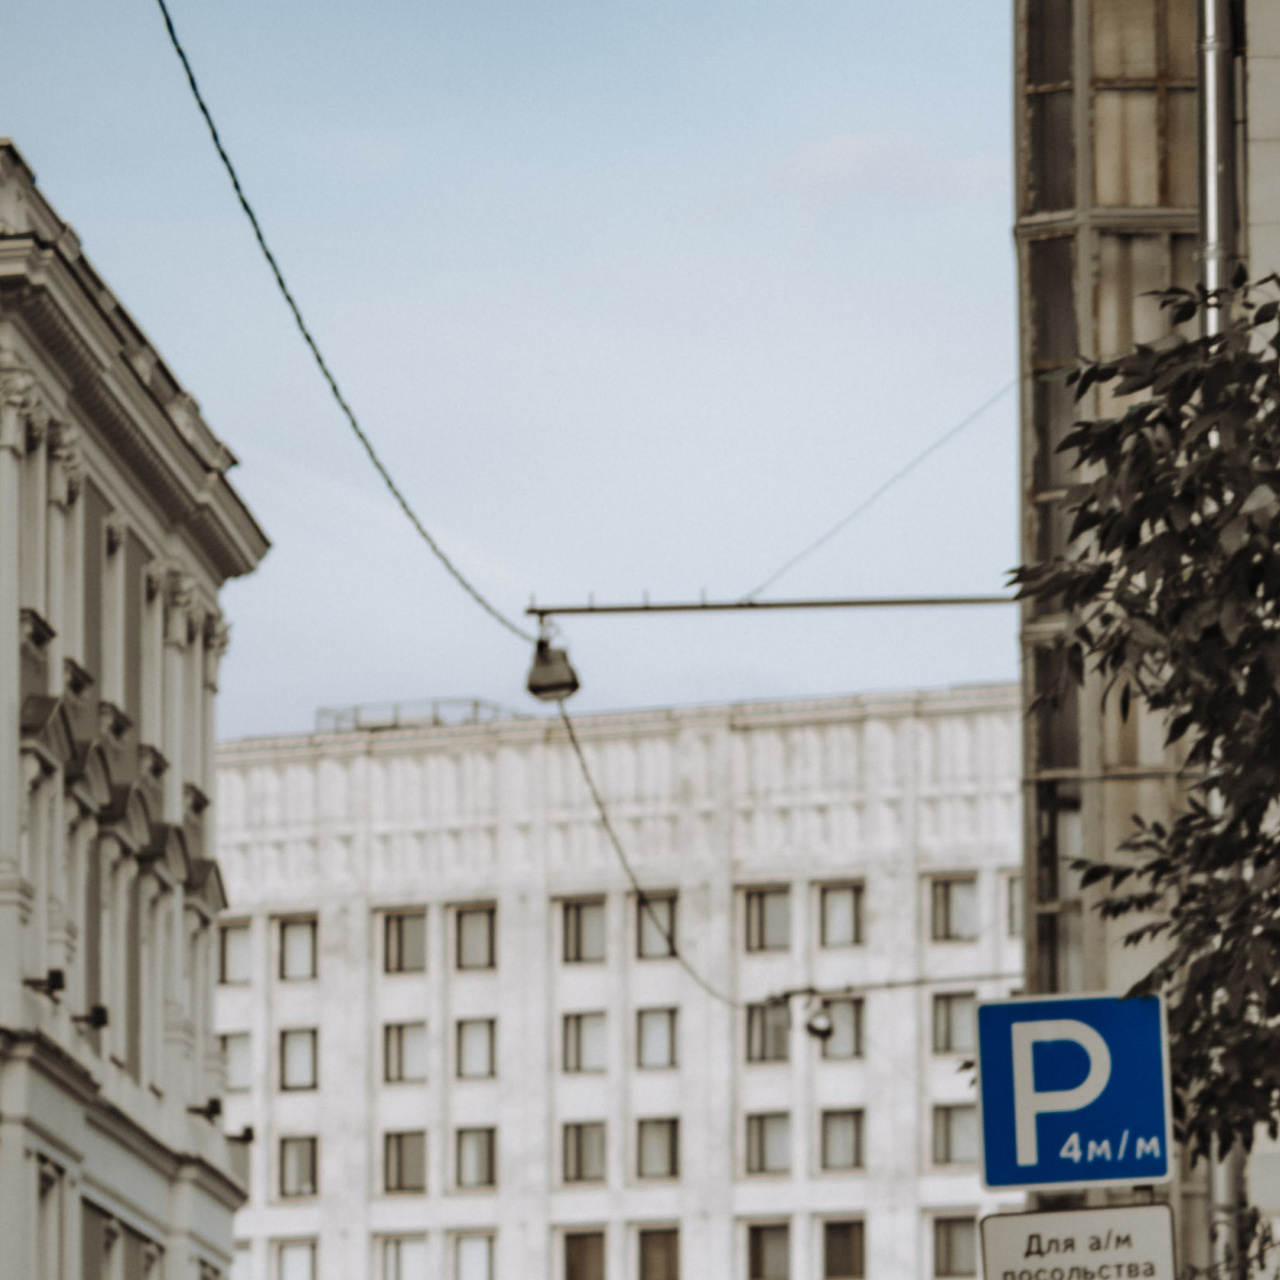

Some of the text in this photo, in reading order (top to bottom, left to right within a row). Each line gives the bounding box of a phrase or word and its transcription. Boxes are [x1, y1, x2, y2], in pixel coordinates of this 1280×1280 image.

[1010, 1018, 1112, 1167] P
[1023, 1228, 1133, 1259] Для а/м
